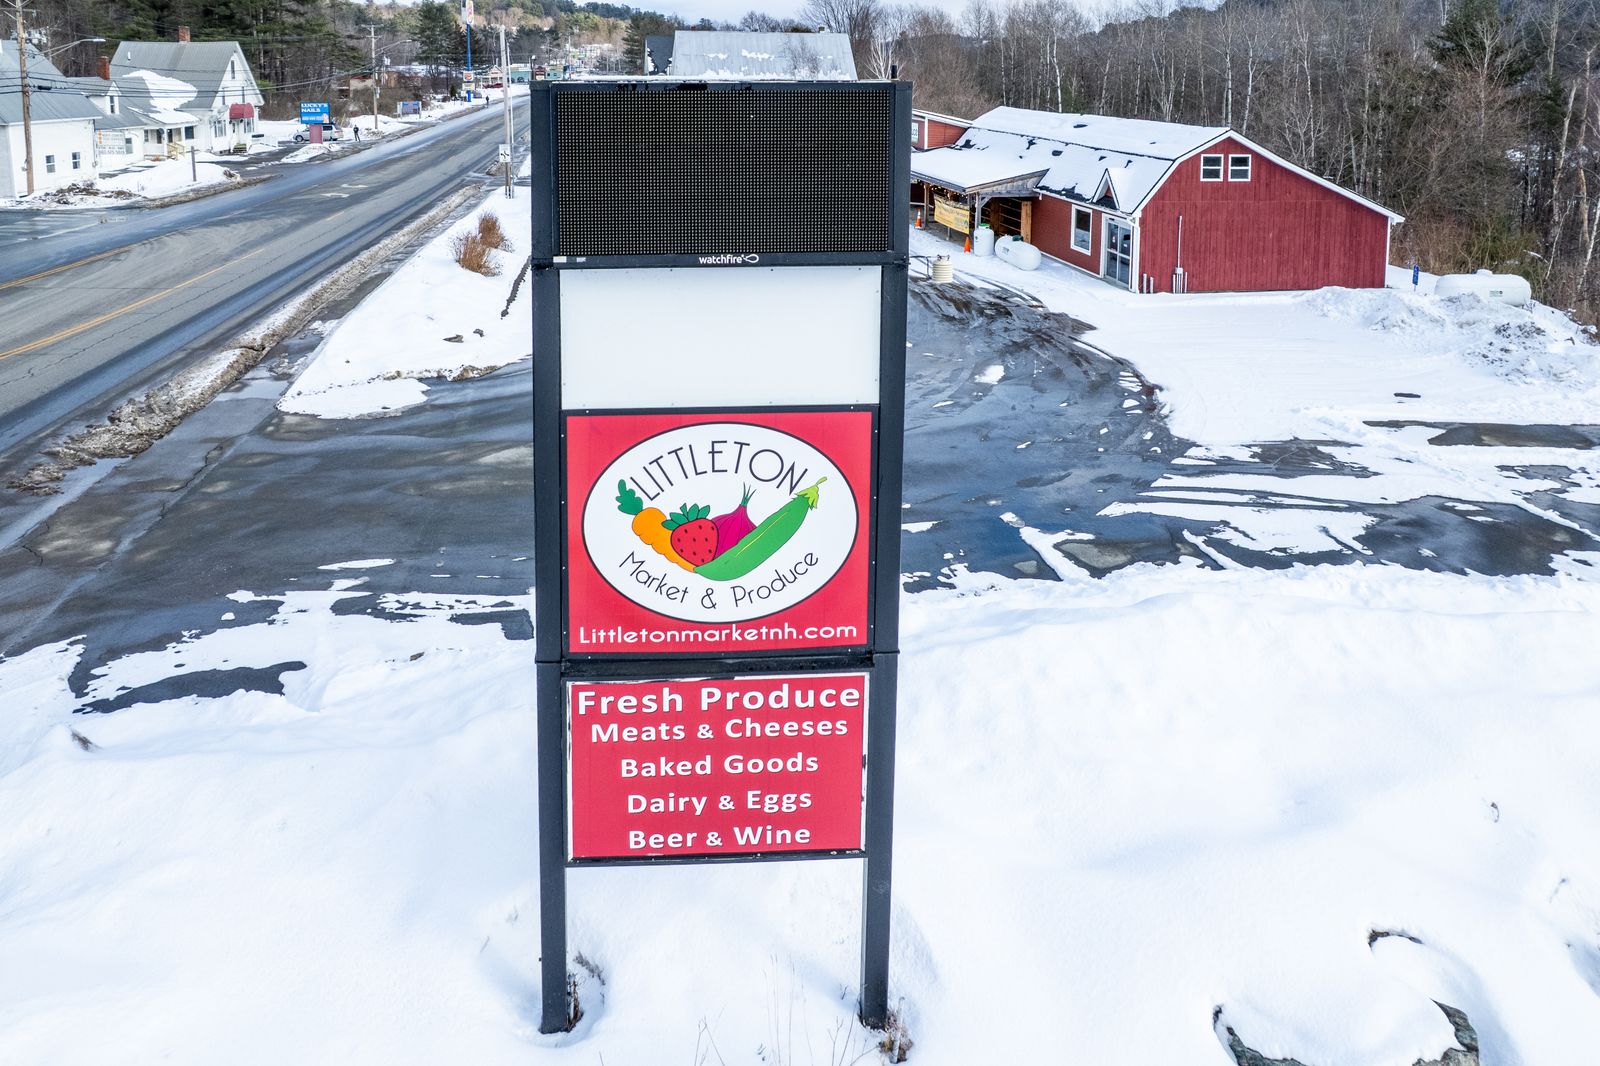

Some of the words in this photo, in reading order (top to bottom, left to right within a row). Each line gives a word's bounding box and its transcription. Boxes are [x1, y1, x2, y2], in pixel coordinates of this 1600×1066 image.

[698, 254, 743, 264] watchfire
[630, 440, 808, 502] LITTLETON
[618, 551, 690, 604] Market
[701, 588, 717, 610] &
[731, 551, 819, 608] Produce
[579, 622, 857, 644] Littletonmarketnh.com
[578, 687, 683, 715] Fresh
[701, 684, 860, 711] Produce
[591, 722, 686, 743] Meats
[697, 723, 714, 739] &
[725, 717, 848, 738] Cheeses
[621, 755, 712, 778] Baked
[724, 752, 819, 774] Goods
[627, 793, 707, 816] Dairy
[718, 795, 735, 810] &
[747, 790, 812, 813] Eggs
[629, 830, 697, 849] Beer
[706, 832, 723, 847] &
[734, 826, 811, 847] Wine
